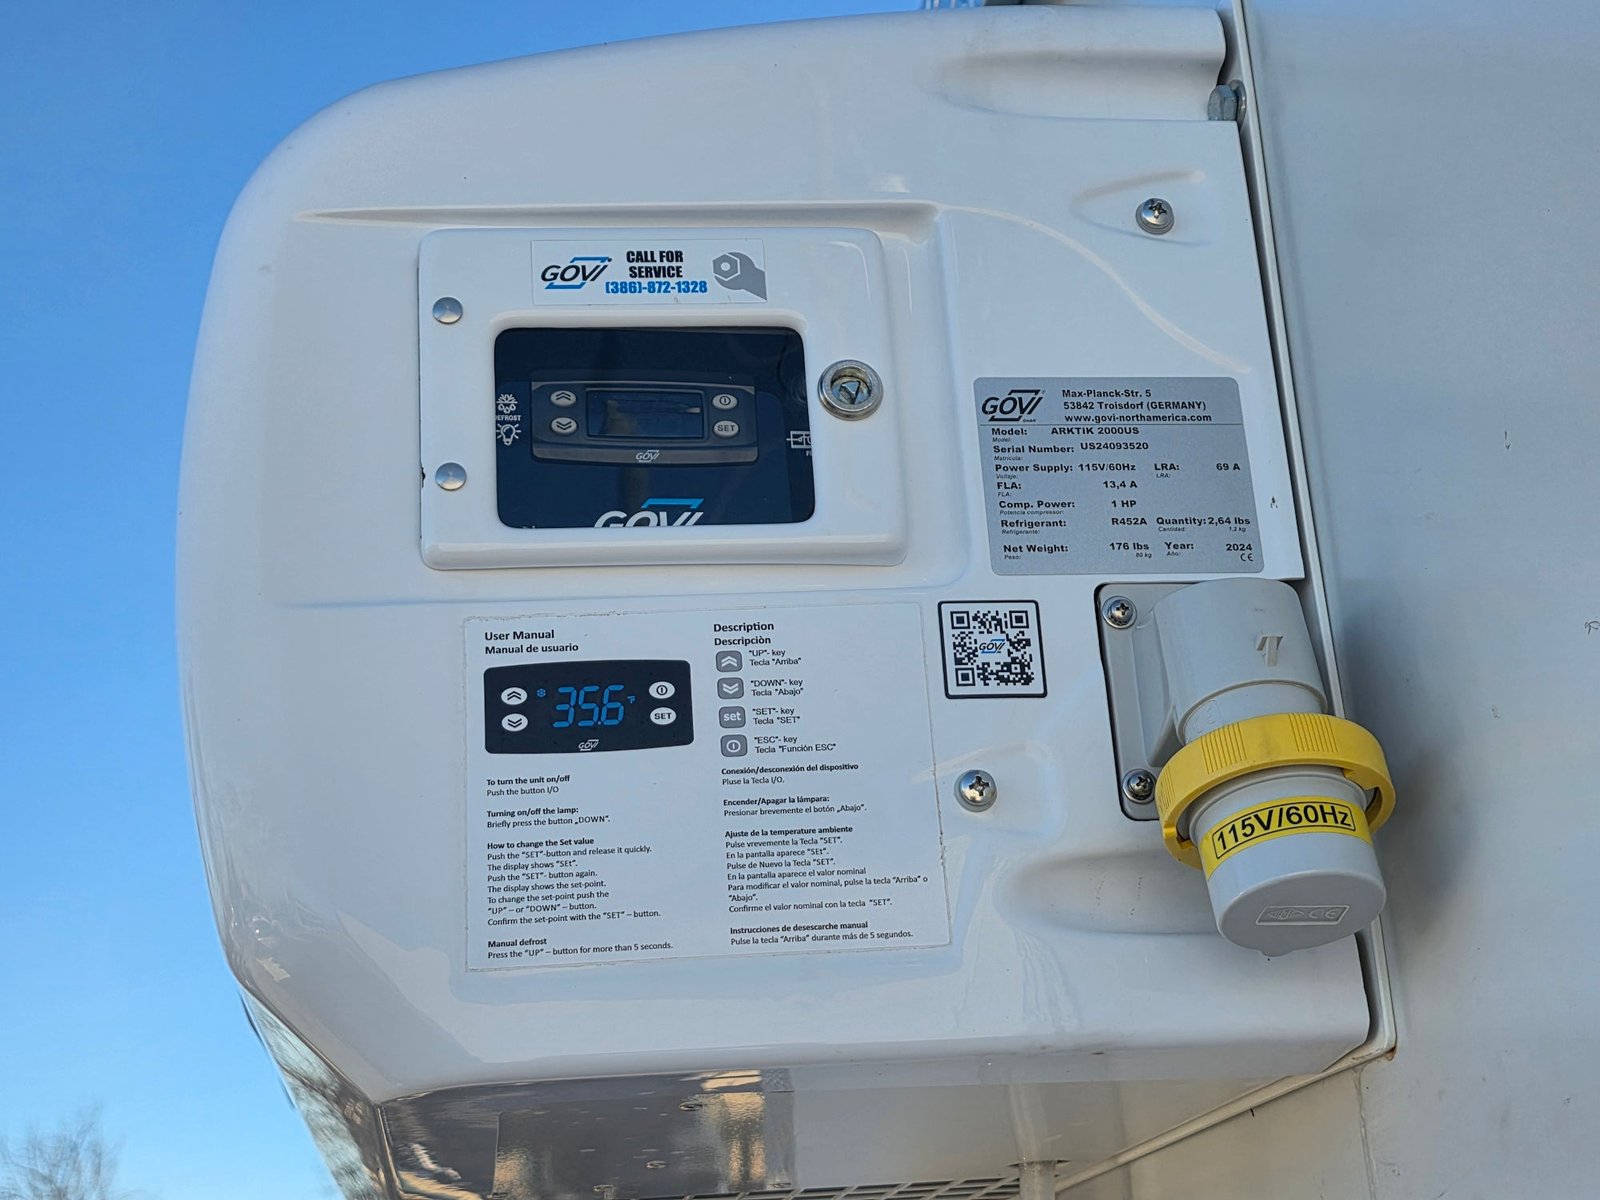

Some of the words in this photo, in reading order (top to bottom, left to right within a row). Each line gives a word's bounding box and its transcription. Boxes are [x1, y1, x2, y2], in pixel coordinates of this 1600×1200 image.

[626, 251, 656, 263] CALL
[659, 250, 683, 262] FOR
[540, 262, 609, 283] GOVI
[629, 265, 683, 278] SERVICE
[605, 280, 708, 294] (386)-872-1328
[1062, 389, 1142, 398] Max-Planck-Str.
[1145, 389, 1152, 398] 5
[982, 394, 1043, 417] GOVI
[1063, 401, 1095, 410] 53842
[1096, 401, 1144, 410] Troisdorf
[1146, 401, 1206, 412] (GERMANY)
[1064, 413, 1212, 424] www.govi-northamerica.com
[717, 424, 735, 432] SET
[991, 428, 1028, 436] Model:
[1051, 427, 1095, 435] ARKTIK
[1097, 426, 1140, 435] 2000US
[993, 445, 1025, 454] Serial
[1028, 445, 1074, 453] Number:
[1080, 442, 1149, 450] US24093520
[636, 451, 660, 461] GOVI
[995, 464, 1030, 472] Power
[1032, 463, 1073, 473] Supply:
[1078, 463, 1136, 471] 115V/60Hz
[1154, 463, 1180, 471] LRA:
[1216, 463, 1229, 471] 69
[1232, 463, 1241, 471] A
[996, 481, 1022, 490] FLA:
[1103, 480, 1126, 490] 13,4
[1129, 480, 1138, 488] A
[998, 500, 1034, 511] Comp.
[1036, 500, 1075, 508] Power:
[1111, 500, 1117, 508] 1
[1121, 500, 1136, 508] HP
[1000, 519, 1066, 529] Refrigerant:
[1111, 517, 1148, 526] R452A
[1156, 516, 1209, 527] Quantity:
[1207, 516, 1232, 527] 2,64
[1234, 517, 1251, 526] lbs
[1003, 544, 1024, 553] Net
[1026, 544, 1068, 554] Weight:
[1109, 542, 1130, 550] 176
[1132, 542, 1150, 550] lbs
[1164, 542, 1194, 550] Year:
[1226, 543, 1253, 552] 2024
[713, 621, 774, 633] Description
[484, 632, 510, 641] User
[512, 629, 554, 640] Manual
[714, 635, 771, 647] Descripciòn
[485, 644, 524, 654] Manual
[526, 644, 539, 653] de
[541, 642, 579, 652] usuario
[979, 640, 1006, 652] GOVI
[748, 658, 770, 667] Tecla
[750, 688, 772, 697] Tecla
[552, 684, 625, 728] 35.6
[654, 712, 672, 720] SET
[723, 711, 742, 722] set
[578, 740, 599, 750] GOVI
[721, 764, 805, 775] Conexión/desconexión
[806, 764, 818, 772] del
[819, 763, 859, 772] dispositivo
[514, 777, 528, 785] the
[529, 776, 545, 784] unit
[546, 774, 570, 784] on/off
[722, 778, 742, 786] Pluse
[742, 777, 750, 785] la
[750, 776, 770, 784] Tecla
[770, 775, 785, 785] I/O.
[486, 788, 505, 796] Push
[506, 788, 519, 796] the
[520, 787, 546, 795] button
[546, 785, 559, 795] I/O
[723, 797, 787, 806] Encender/Apagar
[788, 796, 796, 804] la
[796, 796, 830, 804] lámpara:
[486, 809, 516, 818] Turning
[516, 807, 542, 817] on/off
[542, 807, 556, 815] the
[557, 807, 579, 815] lamp:
[724, 830, 749, 839] Ajuste
[750, 829, 760, 837] de
[769, 828, 817, 837] temperature
[818, 826, 853, 834] ambiente
[1216, 804, 1348, 851] 115V/60Hz
[487, 842, 505, 850] How
[516, 840, 544, 849] change
[544, 839, 558, 847] the
[559, 838, 572, 846] Set
[573, 837, 594, 845] value
[487, 852, 506, 861] Push
[506, 851, 520, 860] the
[572, 848, 587, 856] and
[588, 847, 616, 855] release
[617, 846, 623, 854] it
[624, 845, 652, 855] quickly.
[727, 873, 737, 881] En
[738, 872, 746, 880] la
[746, 871, 776, 881] pantalla
[777, 871, 807, 880] aparece
[808, 869, 816, 877] el
[816, 868, 835, 877] valor
[836, 867, 866, 876] nominal
[487, 885, 502, 893] The
[503, 883, 530, 893] display
[530, 883, 555, 891] shows
[556, 881, 569, 890] the
[570, 880, 606, 889] set-point.
[488, 896, 497, 904] To
[498, 895, 526, 904] change
[526, 894, 540, 902] the
[541, 892, 575, 902] set-point
[576, 890, 595, 901] push
[596, 890, 610, 898] the
[730, 925, 780, 935] Instrucciones
[781, 924, 792, 932] de
[792, 922, 839, 932] desescarche
[840, 920, 868, 930] manual
[488, 939, 518, 948] Manual
[519, 938, 547, 946] defrost
[730, 937, 751, 946] Pulse
[752, 936, 759, 944] la
[760, 935, 779, 944] tecla
[811, 934, 841, 942] durante
[842, 932, 858, 940] más
[858, 931, 869, 940] de
[870, 931, 875, 939] 5
[876, 930, 914, 940] segundos.
